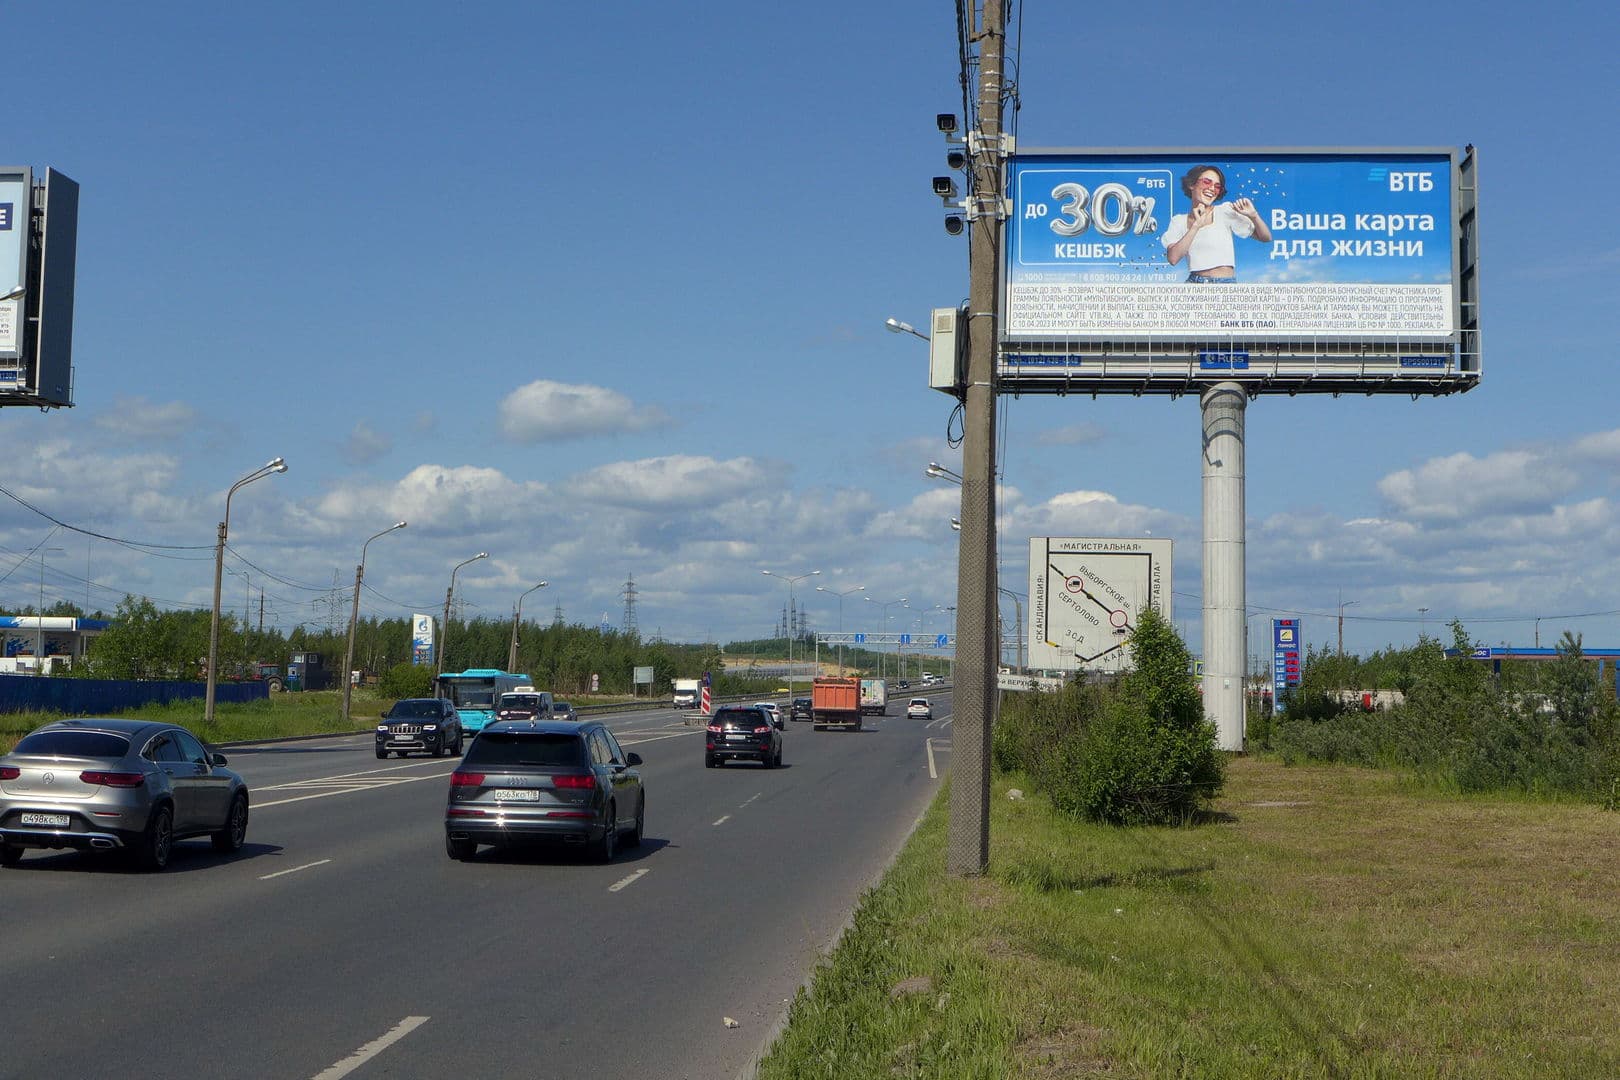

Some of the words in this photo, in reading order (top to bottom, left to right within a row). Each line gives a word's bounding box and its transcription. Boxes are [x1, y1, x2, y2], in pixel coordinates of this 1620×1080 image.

[1146, 178, 1166, 188] ВТБ
[1390, 172, 1434, 192] ВТБ
[1024, 204, 1048, 219] ДО
[1050, 182, 1158, 237] 30%
[1271, 209, 1346, 230] Ваша
[1355, 214, 1434, 236] карта
[1055, 244, 1126, 258] КЕШБЭК
[1270, 239, 1322, 260] для
[1332, 239, 1424, 257] жизни
[1080, 566, 1125, 603] ВЫБОРГСКОЕ
[1058, 592, 1100, 626] СЕРТОЛОВО
[1066, 630, 1084, 644] ЗСД
